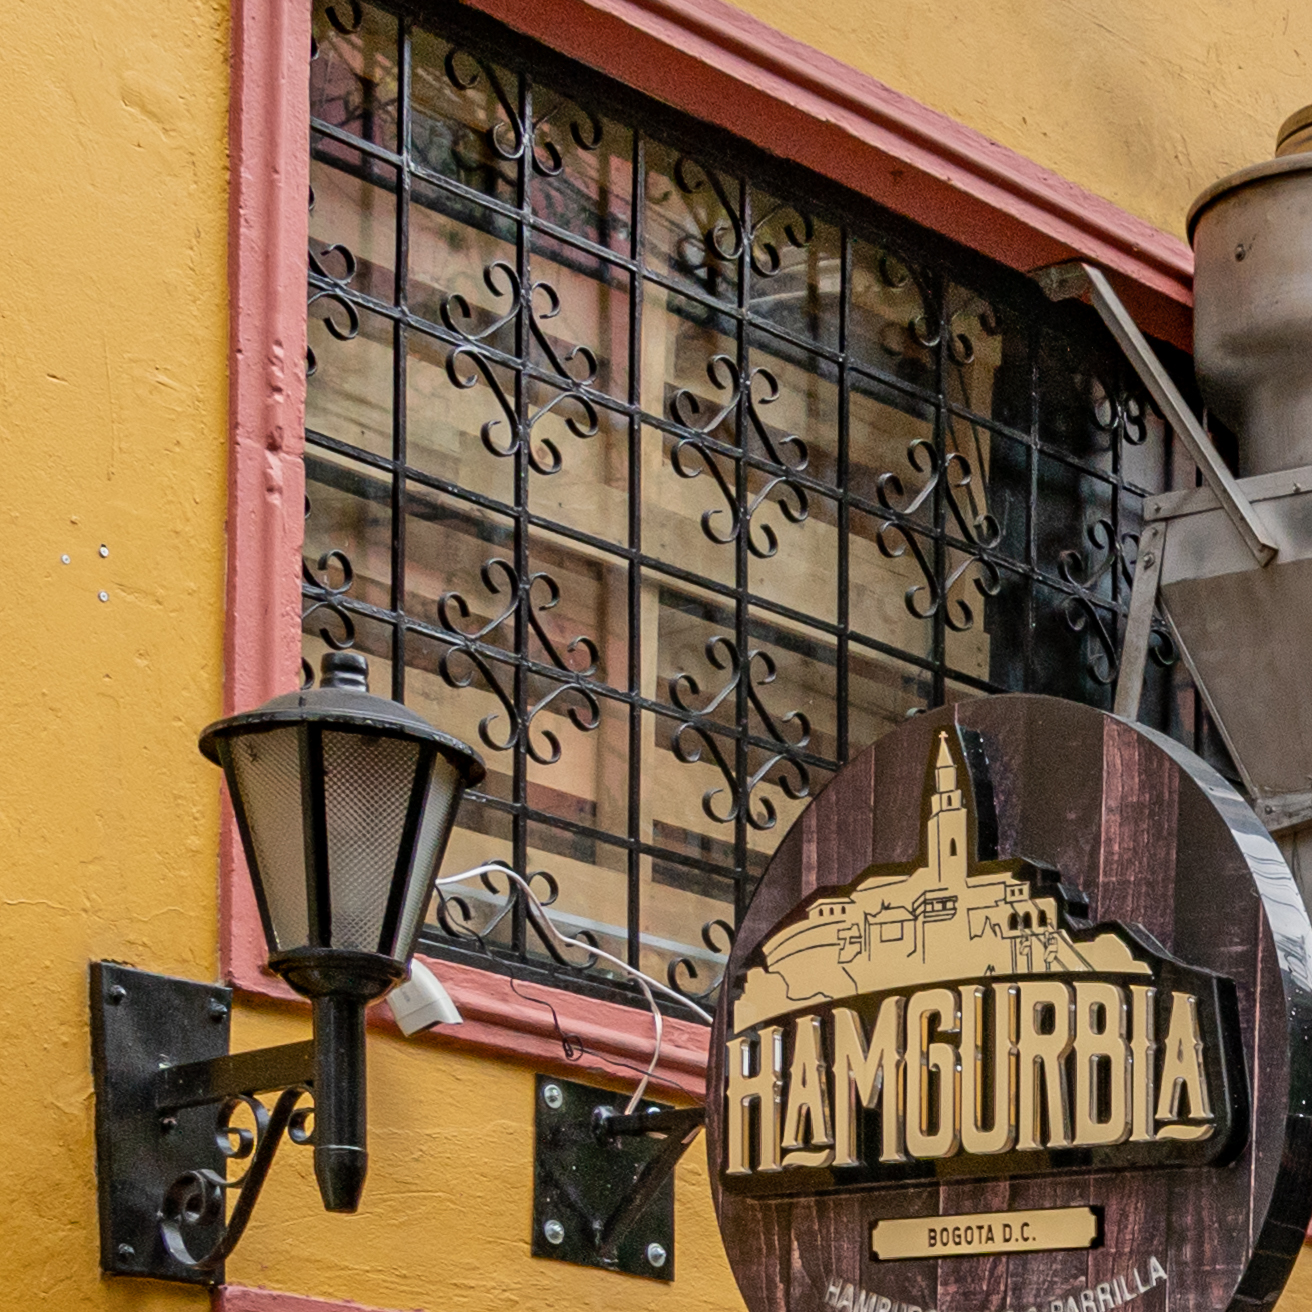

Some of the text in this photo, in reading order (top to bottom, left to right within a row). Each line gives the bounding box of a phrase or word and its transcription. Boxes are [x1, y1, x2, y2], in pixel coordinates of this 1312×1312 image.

[726, 980, 1216, 1176] HAMGURBIA
[928, 1221, 1037, 1248] BOGOTA D.C.
